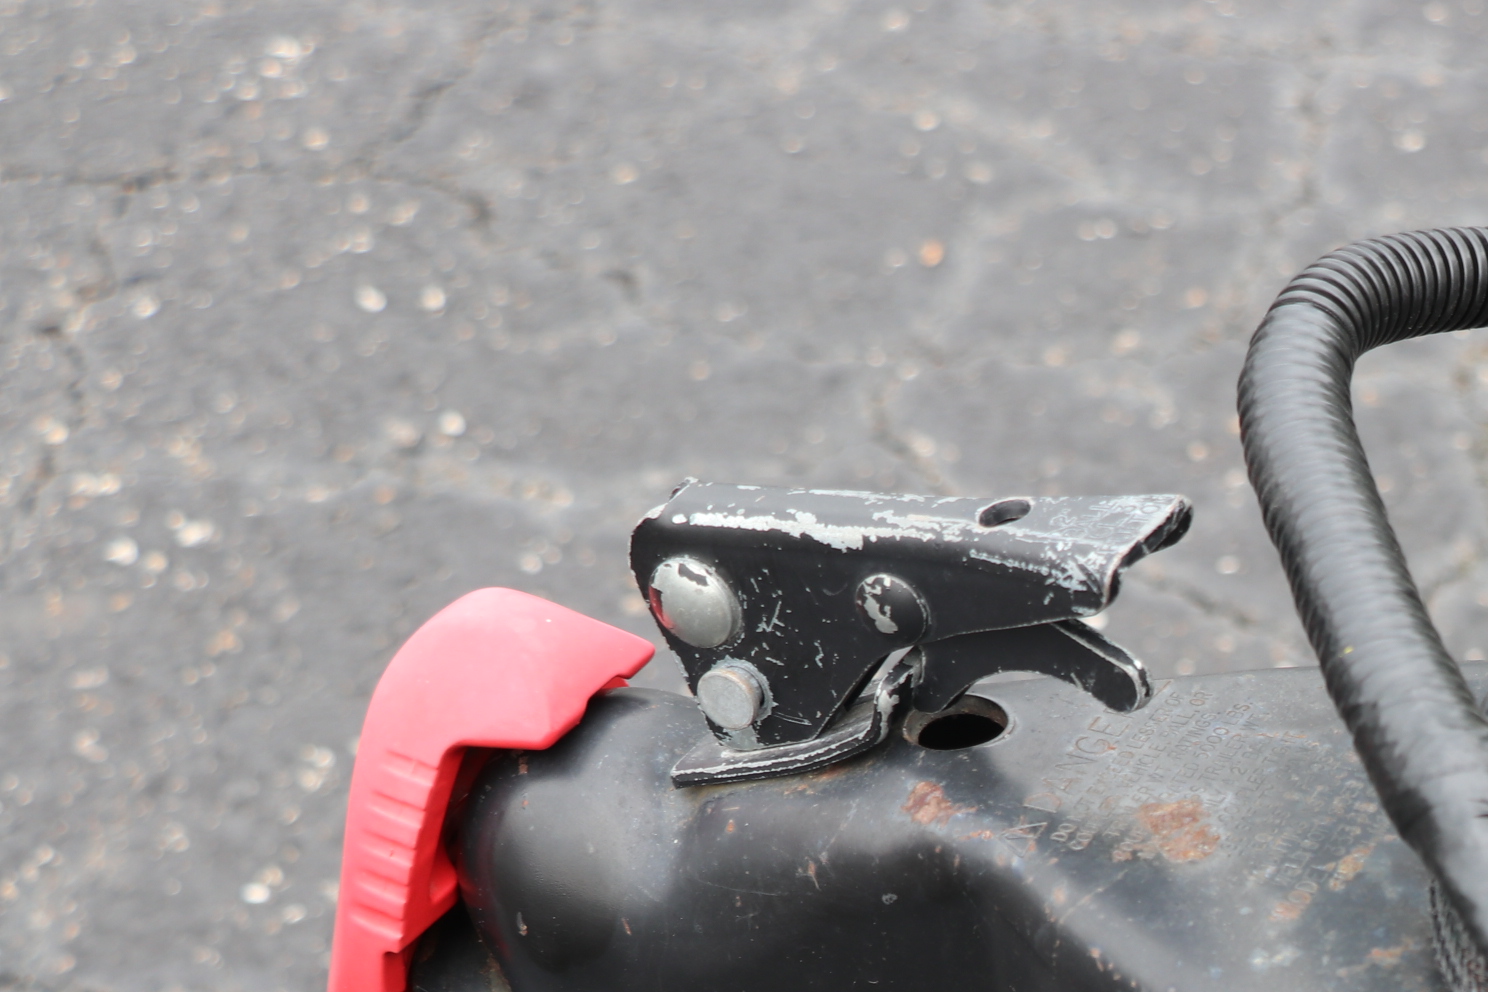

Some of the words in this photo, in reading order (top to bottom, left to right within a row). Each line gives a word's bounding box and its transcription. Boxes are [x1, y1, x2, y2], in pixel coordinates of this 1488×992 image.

[1185, 688, 1214, 708] OR
[1189, 725, 1232, 761] 5000
[1218, 697, 1255, 727] LBS.
[1020, 707, 1137, 815] DANGE
[1165, 706, 1222, 761] RATINGS.
[1195, 731, 1252, 785] TRAILER
[1237, 707, 1271, 734] WT.
[1047, 821, 1078, 843] DO
[1123, 704, 1175, 751] LESSER
[1162, 691, 1186, 707] OF
[1225, 759, 1253, 777] 2"
